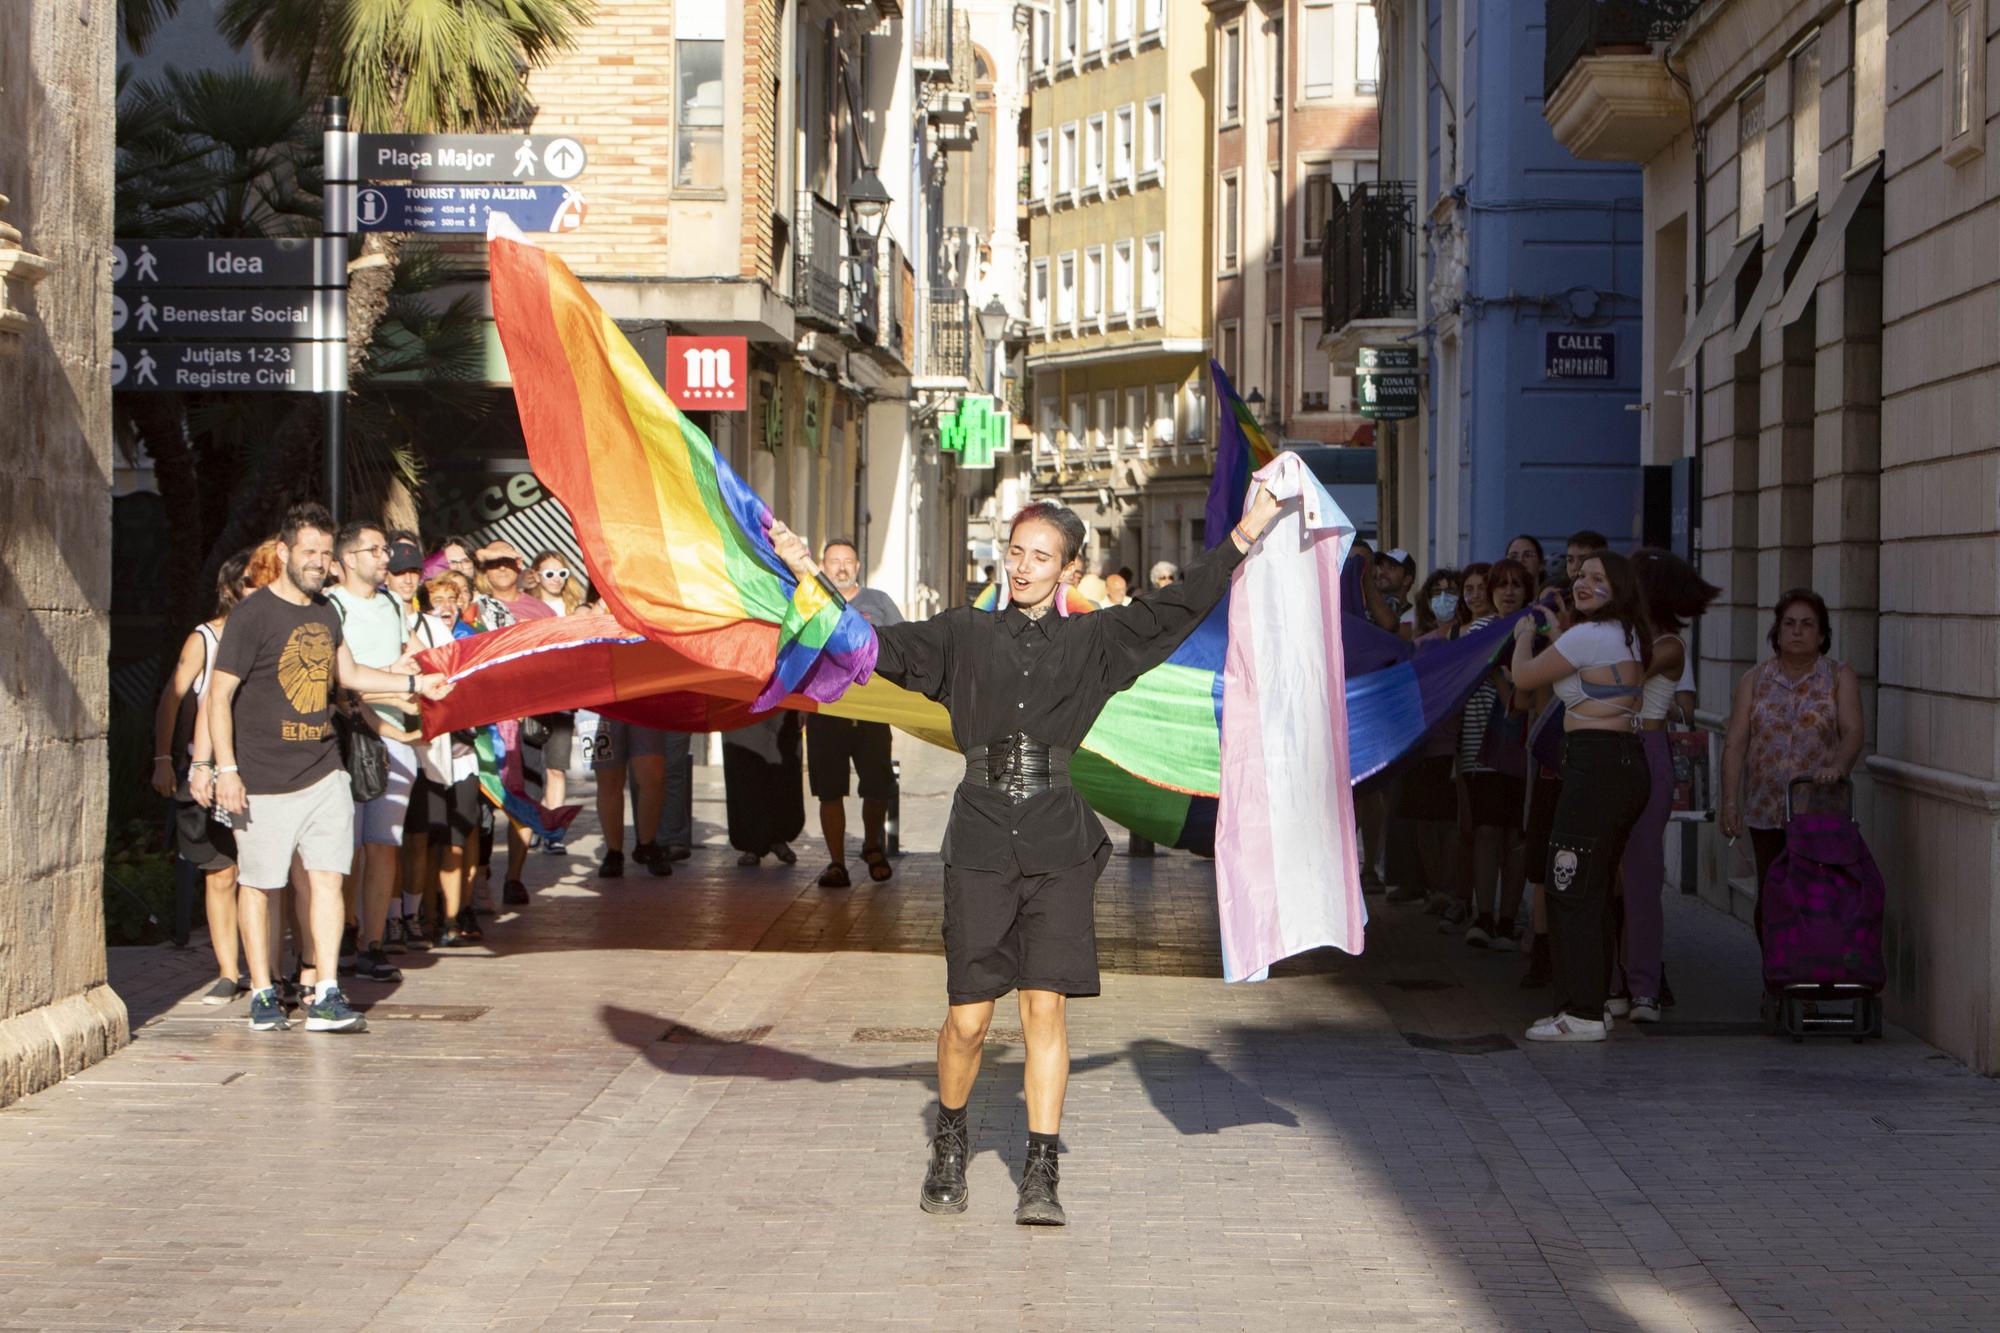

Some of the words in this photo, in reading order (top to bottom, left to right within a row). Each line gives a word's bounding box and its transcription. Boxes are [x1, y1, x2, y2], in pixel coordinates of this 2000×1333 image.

[378, 148, 432, 169] Plaça
[438, 148, 495, 170] Major
[404, 187, 455, 200] TOURIST
[460, 187, 490, 200] INFO
[492, 187, 537, 200] ALZIRA
[207, 251, 263, 273] Idea
[162, 305, 246, 322] Benestar
[251, 305, 308, 322] Social
[1558, 335, 1602, 350] CALLE
[181, 347, 242, 366] Jutjats
[247, 347, 291, 362] 1-2-3
[176, 368, 251, 388] Registre
[255, 368, 296, 384] Civil
[1381, 377, 1404, 386] ZONA
[1379, 386, 1417, 395] VIANANTS
[282, 726, 297, 738] EL
[582, 733, 614, 762] 22
